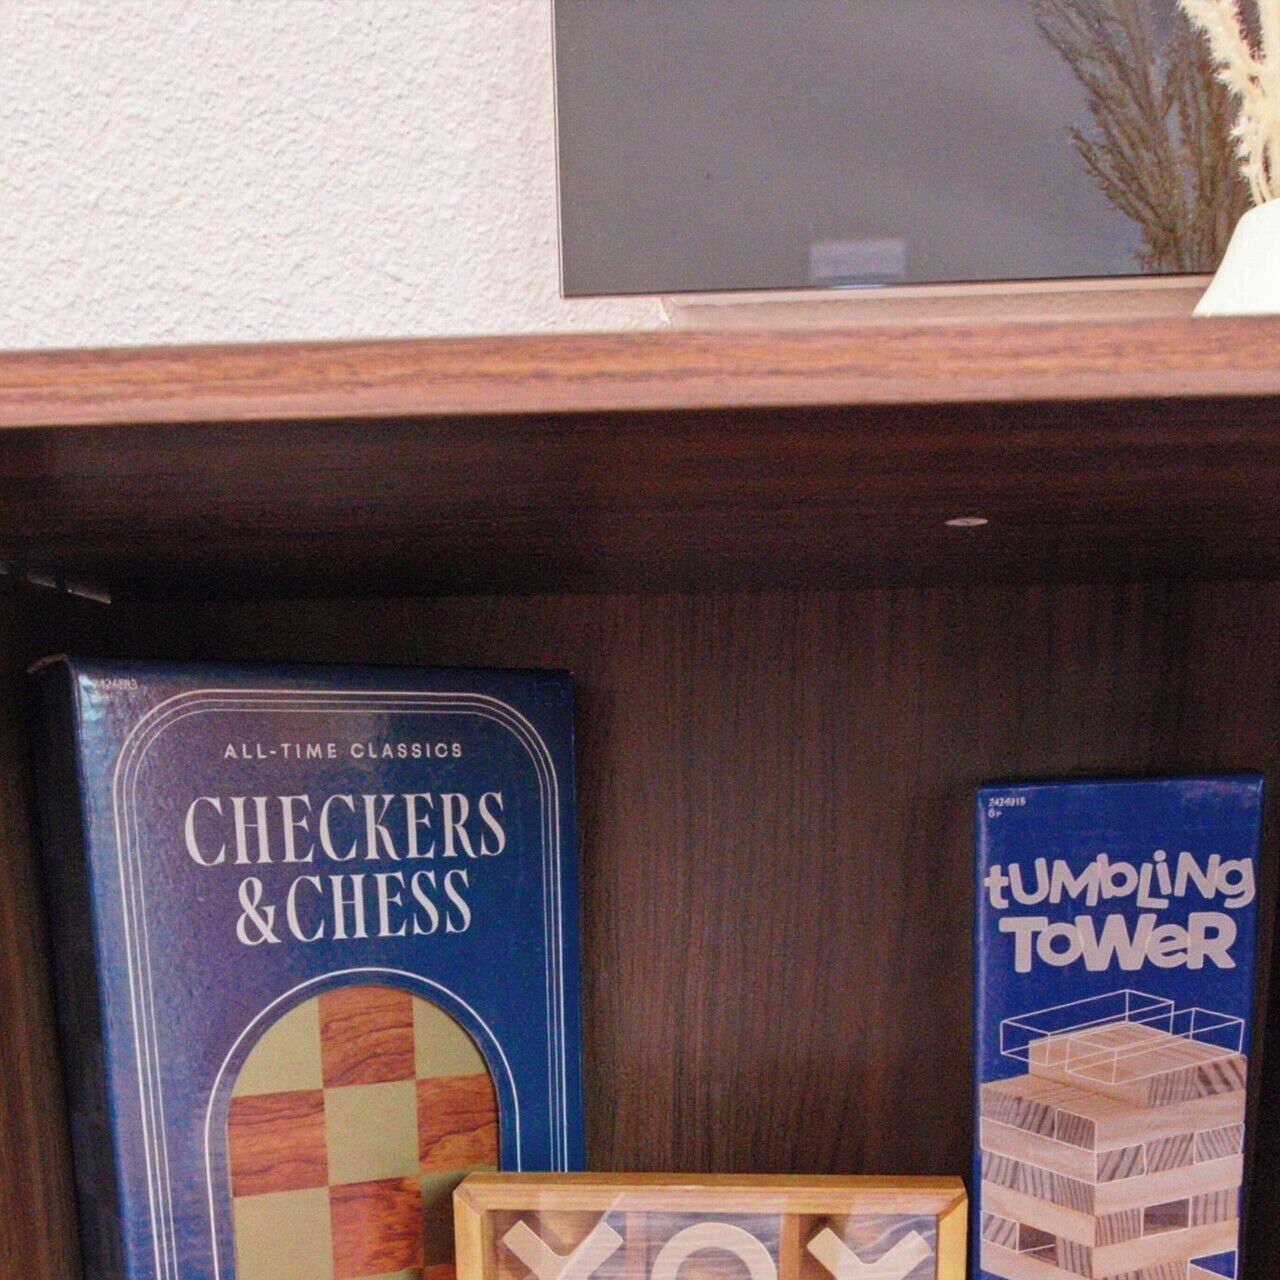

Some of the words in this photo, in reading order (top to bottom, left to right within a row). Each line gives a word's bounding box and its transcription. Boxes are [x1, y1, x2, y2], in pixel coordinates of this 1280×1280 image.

[224, 742, 338, 760] ALL-TIME
[350, 742, 463, 759] CLASSICS
[183, 791, 507, 866] CHECKERS
[235, 869, 472, 946] &CHESS
